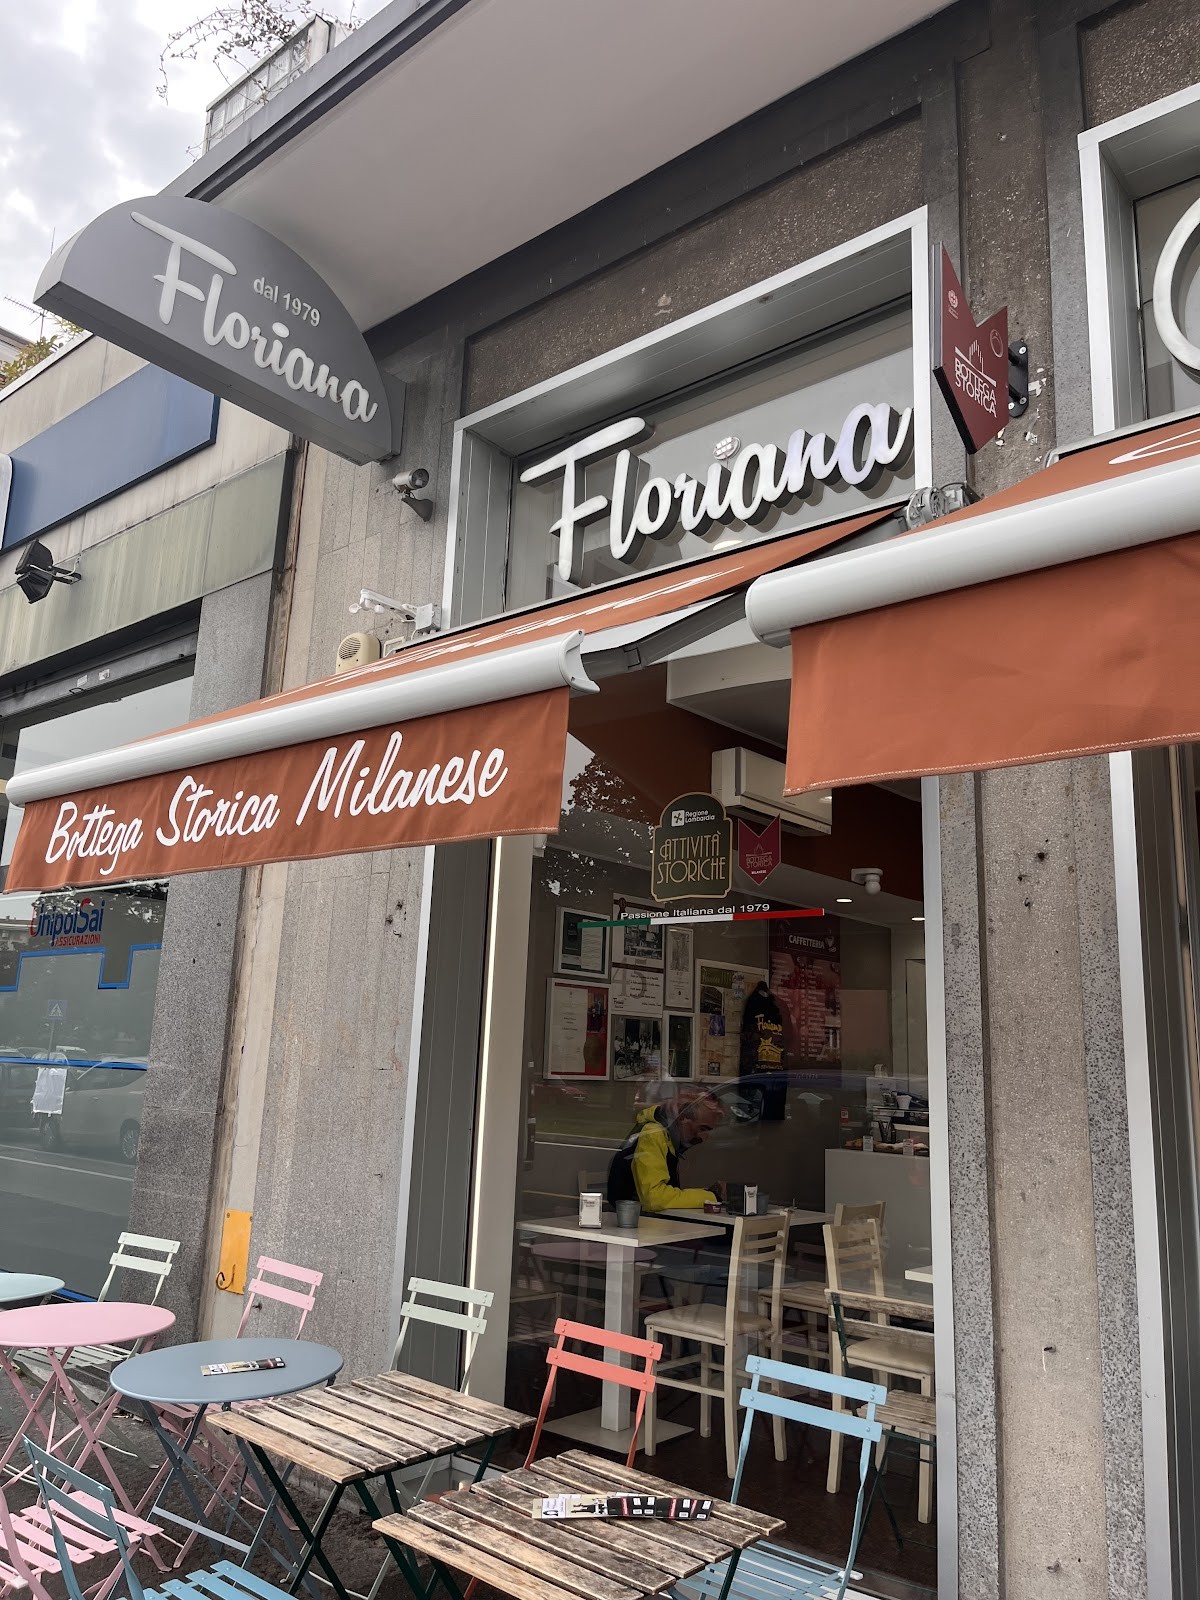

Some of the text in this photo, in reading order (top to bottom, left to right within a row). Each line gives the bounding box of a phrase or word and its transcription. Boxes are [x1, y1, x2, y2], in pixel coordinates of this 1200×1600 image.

[130, 211, 379, 423] Floriana
[253, 276, 321, 328] dal 1979
[954, 357, 997, 406] BOTTEGA
[954, 371, 997, 418] STORICA
[519, 402, 913, 581] Floriana
[45, 730, 509, 876] Bottega Storica Milanese
[685, 810, 709, 818] Regione
[685, 814, 716, 823] Lombardia
[659, 830, 722, 861] ATTIVITÀ
[656, 856, 726, 885] STORICHE
[620, 903, 770, 921] Passione Italiana dal 1979
[788, 934, 825, 950] CAFFETTERIA
